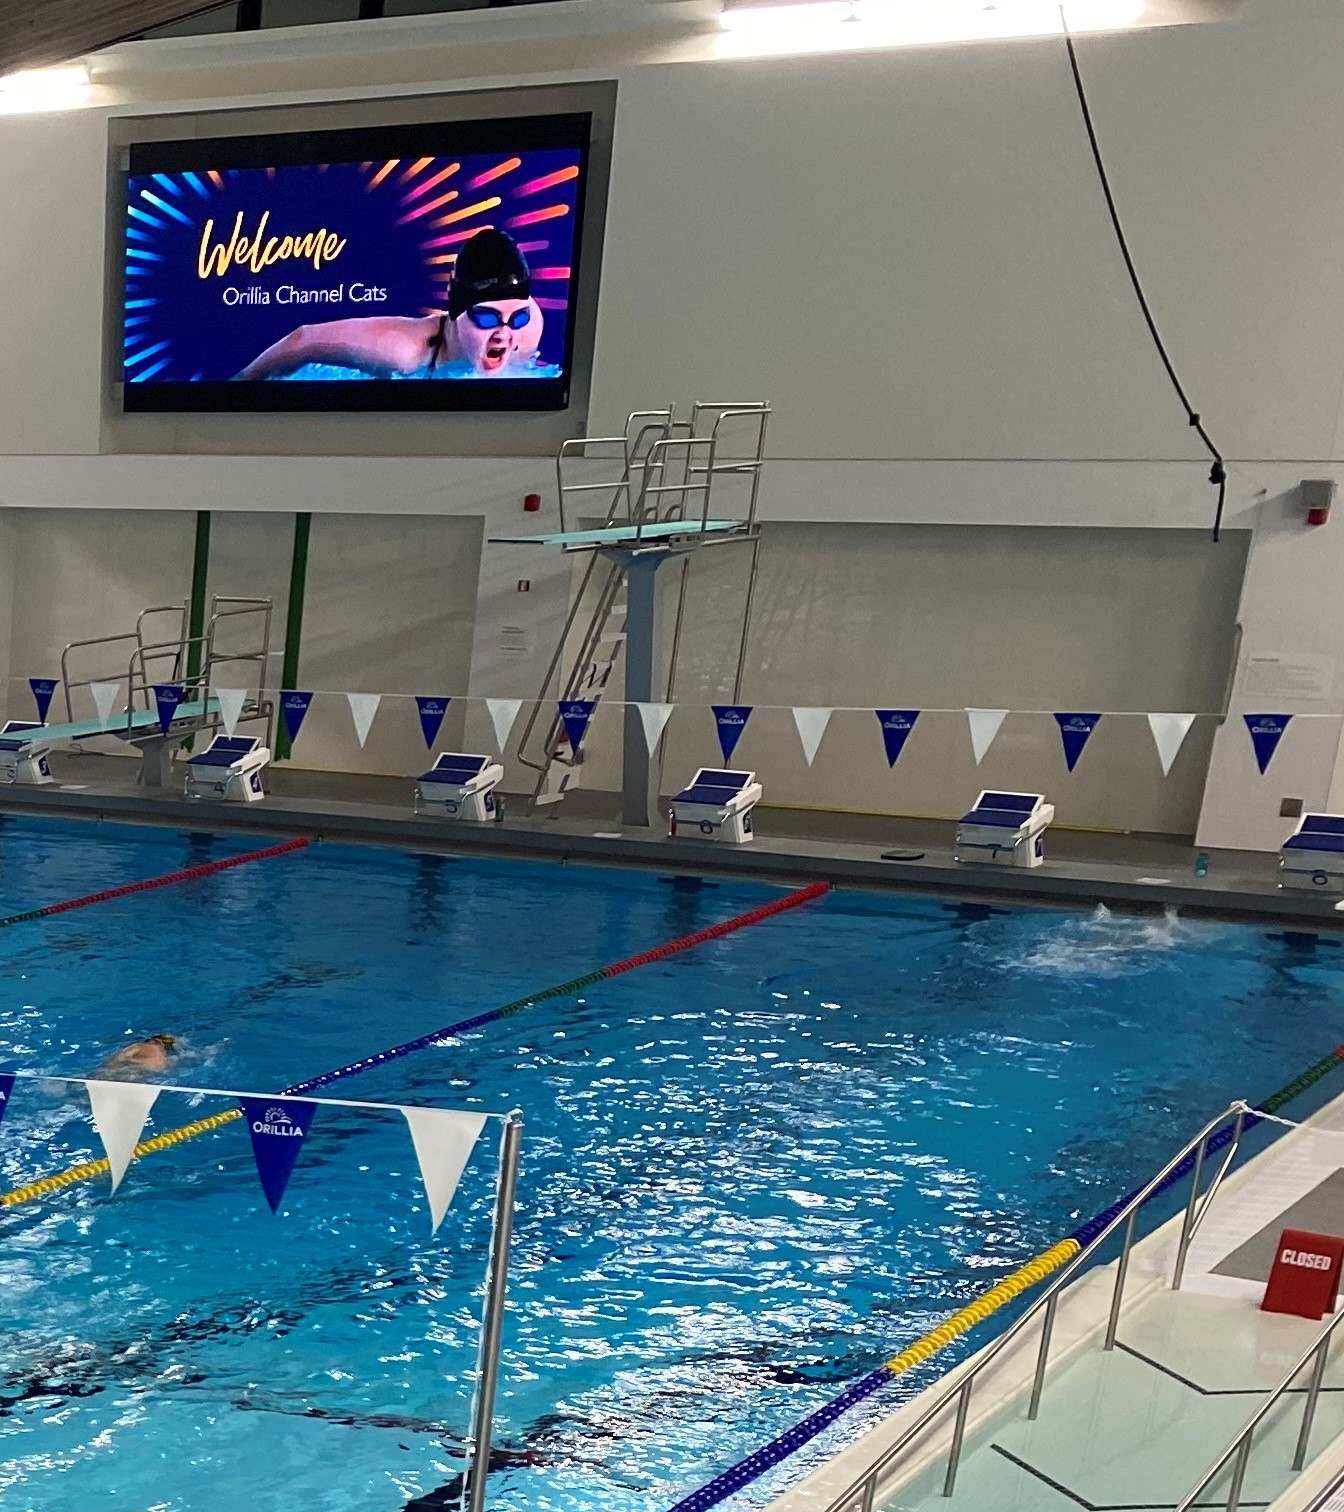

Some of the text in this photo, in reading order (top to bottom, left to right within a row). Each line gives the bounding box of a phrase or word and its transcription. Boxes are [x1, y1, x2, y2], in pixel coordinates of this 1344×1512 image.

[196, 210, 347, 280] Welcome
[223, 282, 387, 305] Orillia Channel Cats
[252, 1121, 303, 1138] ORILLIA
[1280, 1248, 1332, 1271] CLOSED
